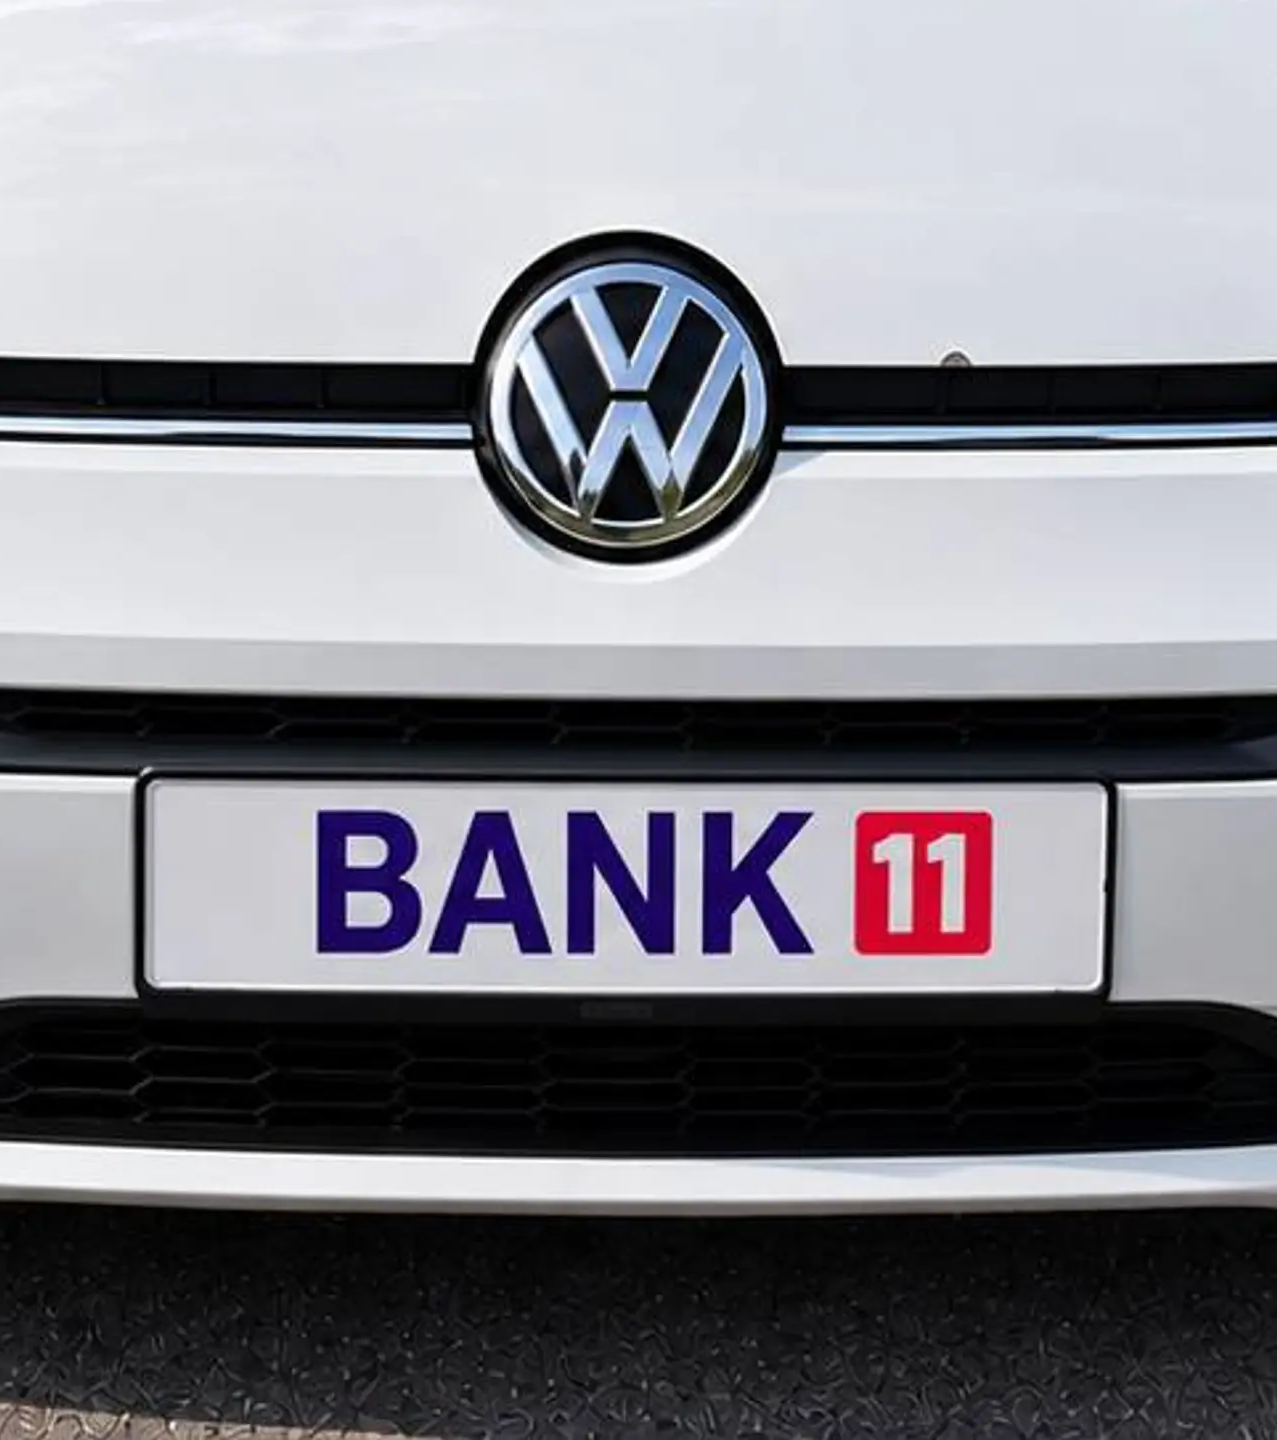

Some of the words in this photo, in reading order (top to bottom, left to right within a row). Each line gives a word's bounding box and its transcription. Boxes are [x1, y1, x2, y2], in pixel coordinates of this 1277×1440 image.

[491, 264, 767, 547] VW
[316, 810, 816, 956] BANK
[871, 831, 966, 935] 11
